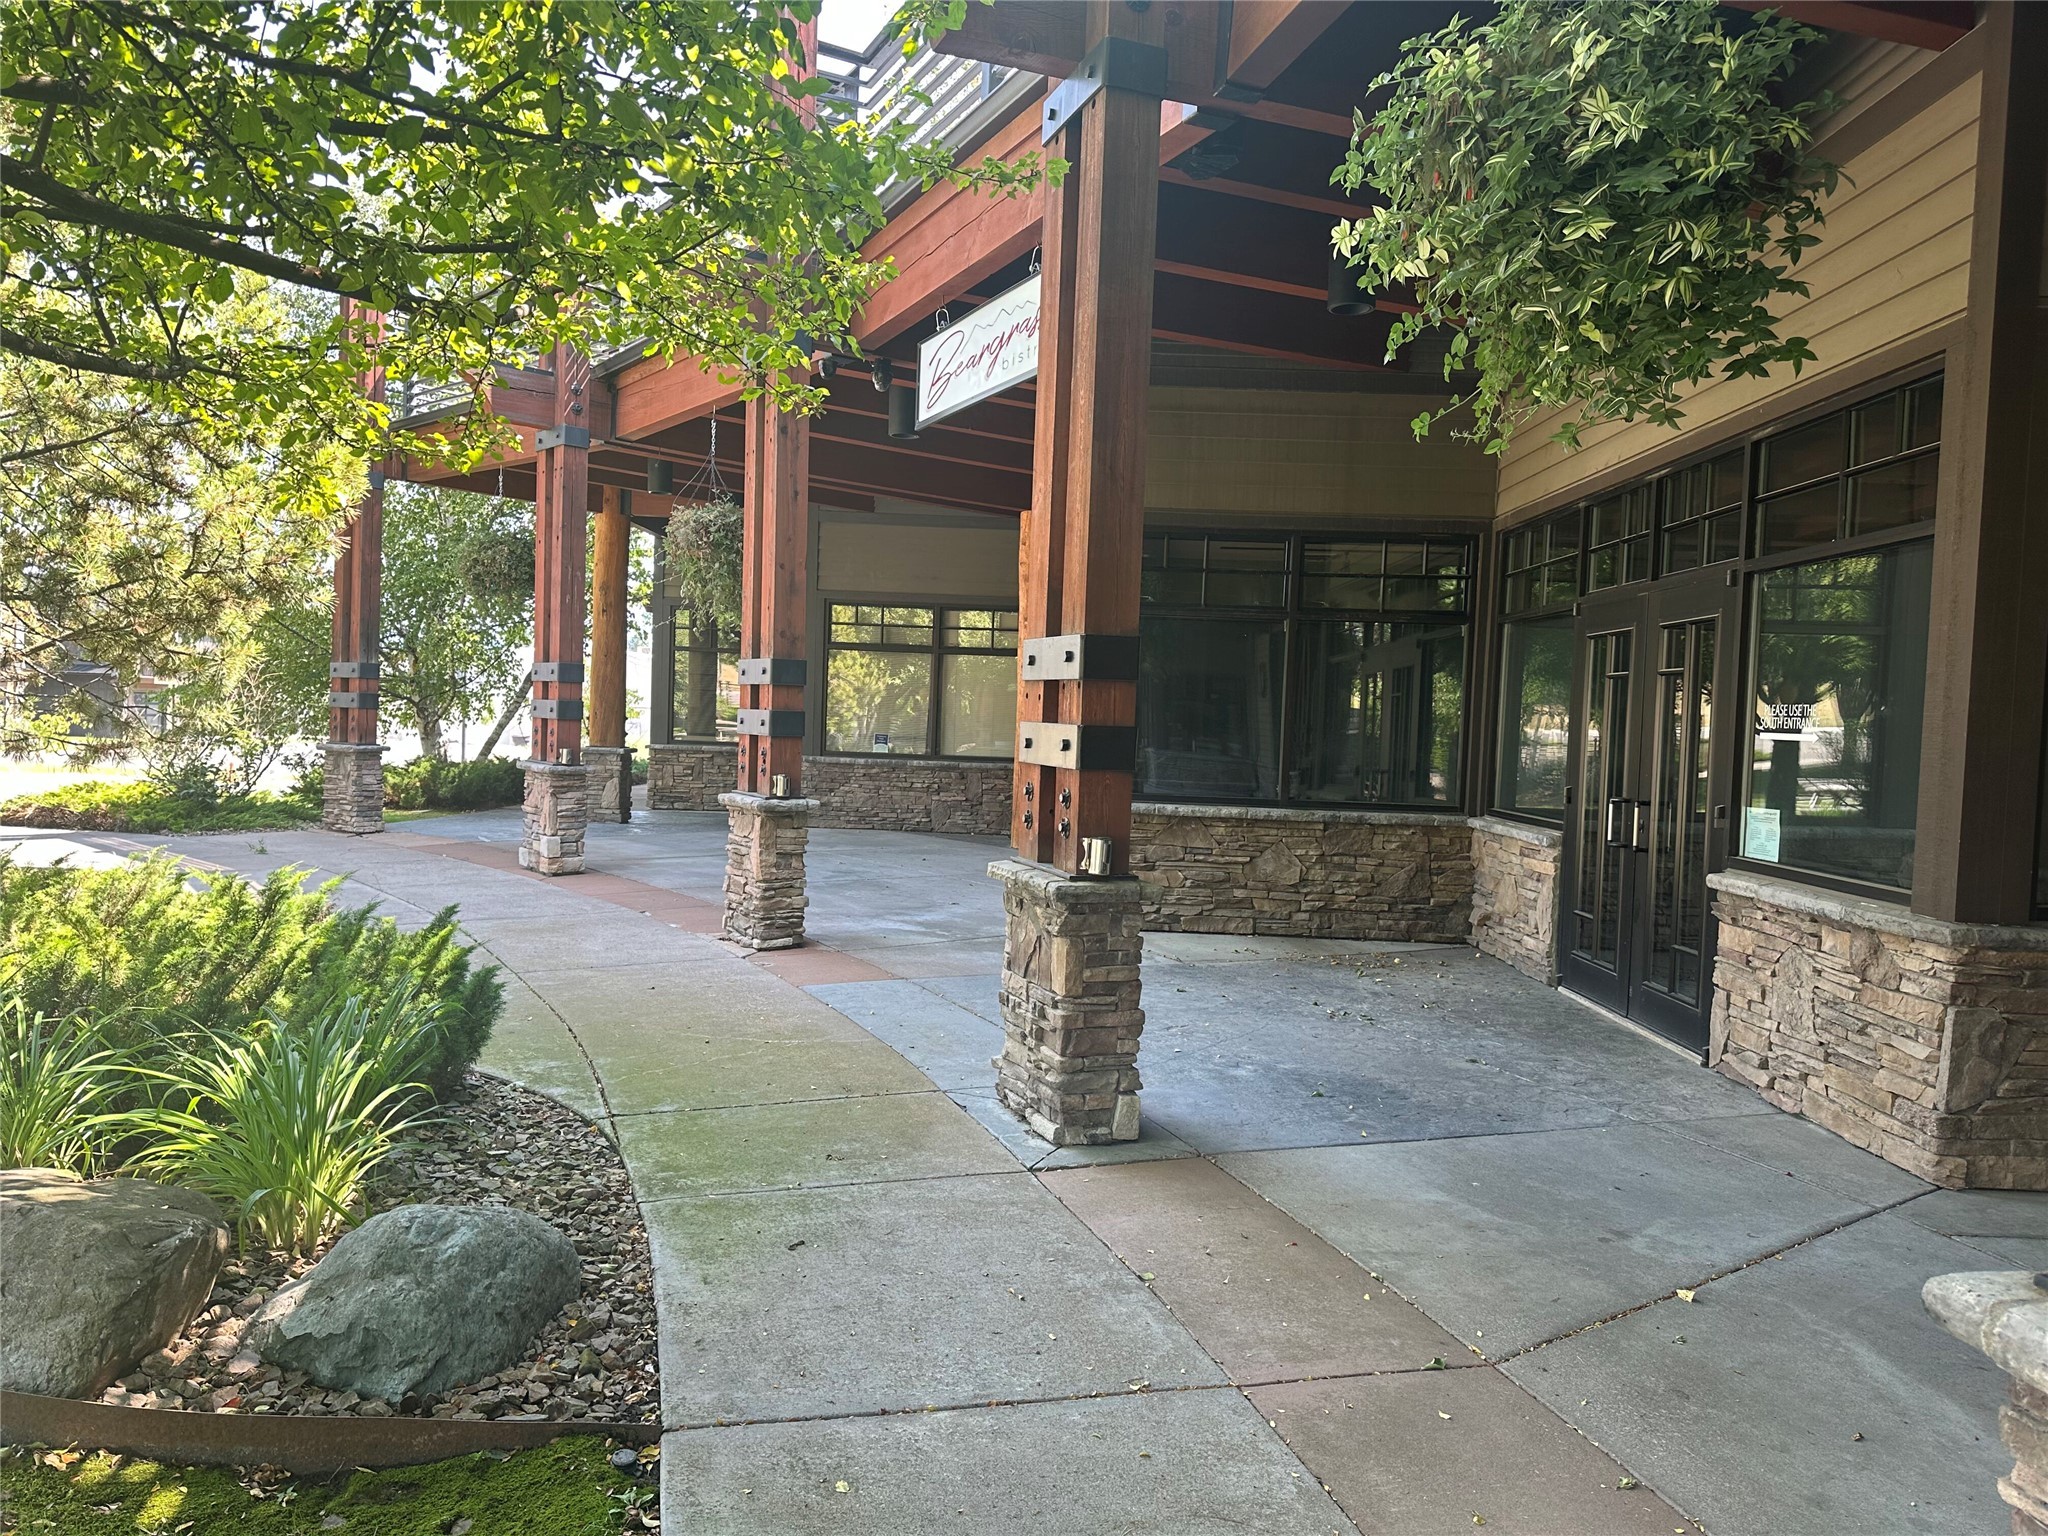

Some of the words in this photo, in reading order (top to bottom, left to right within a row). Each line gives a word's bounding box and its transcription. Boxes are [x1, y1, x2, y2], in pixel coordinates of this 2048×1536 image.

[927, 306, 1041, 409] Beargras
[1002, 344, 1038, 370] bistr
[1765, 704, 1788, 716] PLEASE
[1789, 704, 1802, 716] USE
[1803, 704, 1817, 716] THE
[1761, 717, 1783, 729] SOUTH
[1784, 717, 1820, 729] ENTRANCE
